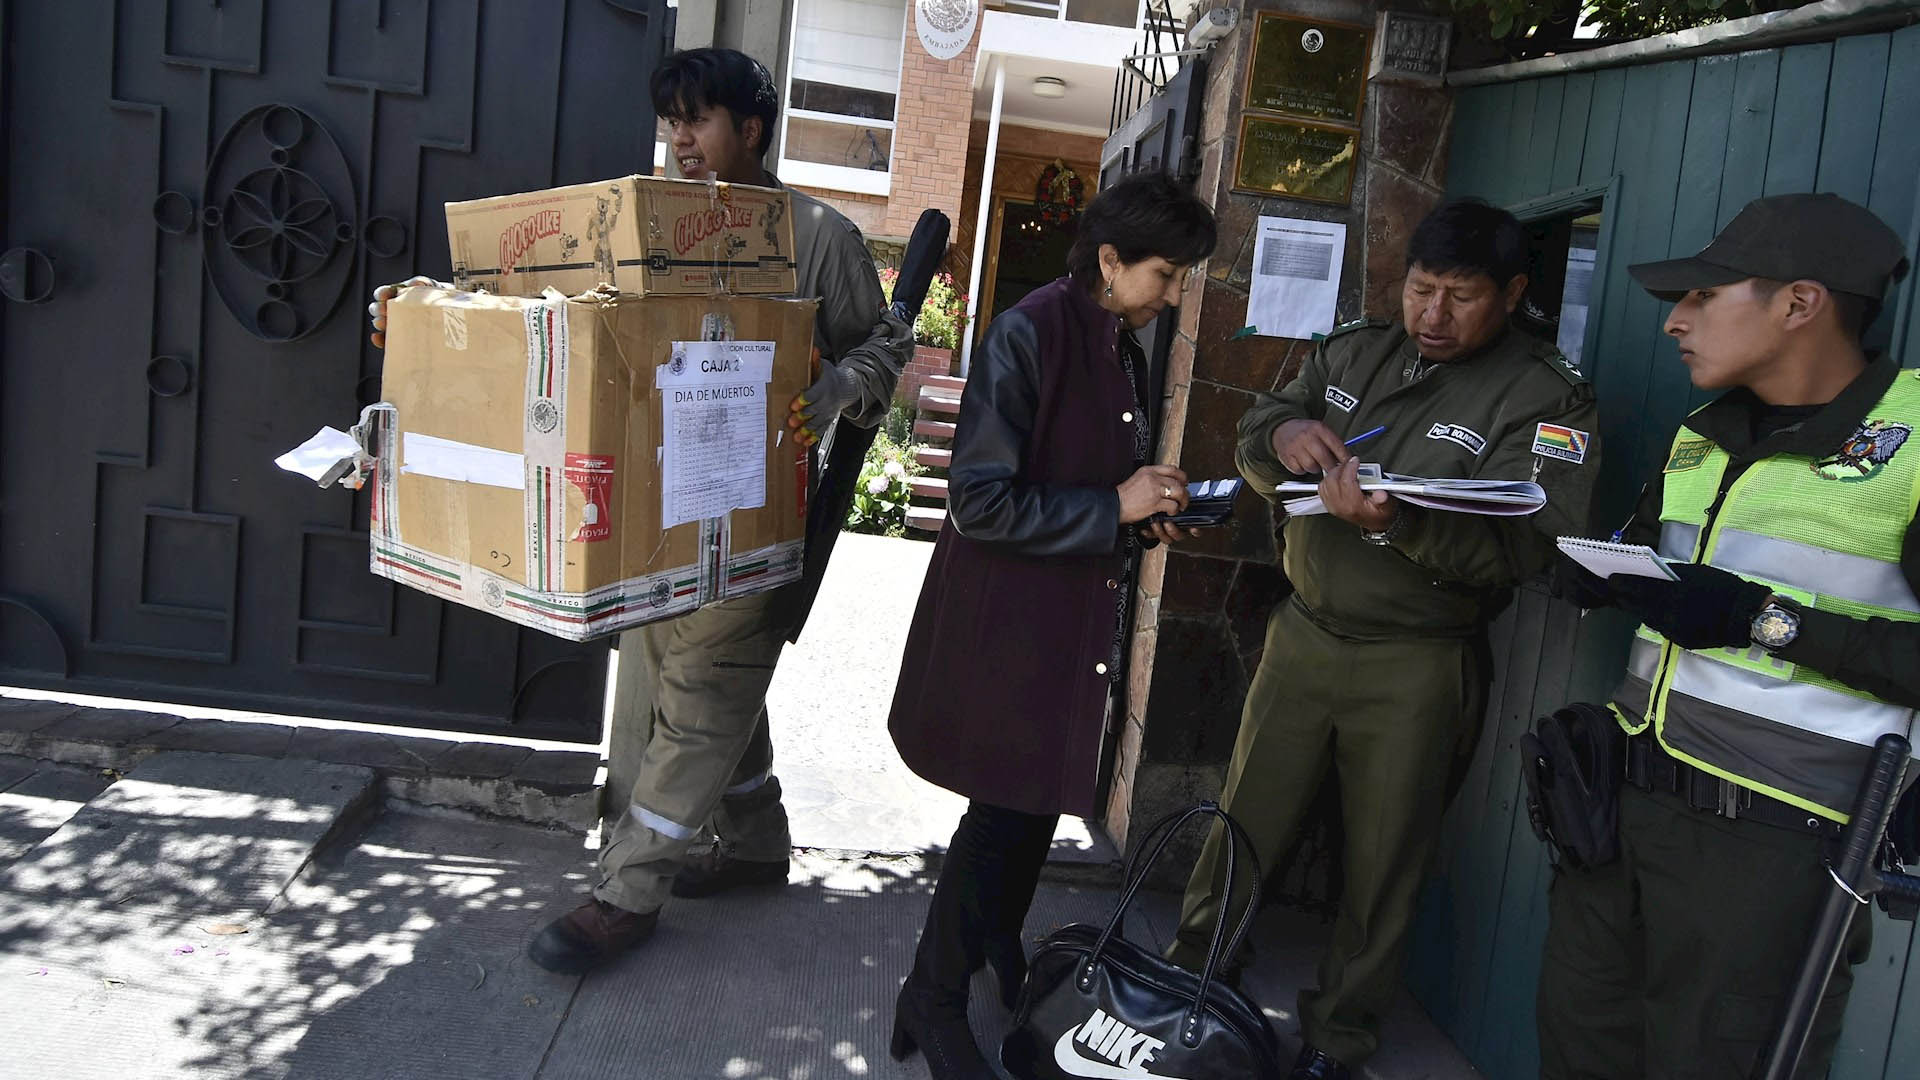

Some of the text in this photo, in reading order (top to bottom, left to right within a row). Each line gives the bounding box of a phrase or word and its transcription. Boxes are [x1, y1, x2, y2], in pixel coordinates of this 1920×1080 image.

[500, 210, 561, 275] CHOCOLIKE
[532, 305, 540, 336] MEXIC
[701, 359, 741, 373] CAJA 2
[675, 386, 755, 403] DIA DE MUERTOS
[571, 474, 607, 484] FRAGIL
[578, 527, 609, 539] FRAGI
[1075, 1008, 1166, 1074] NIKE
